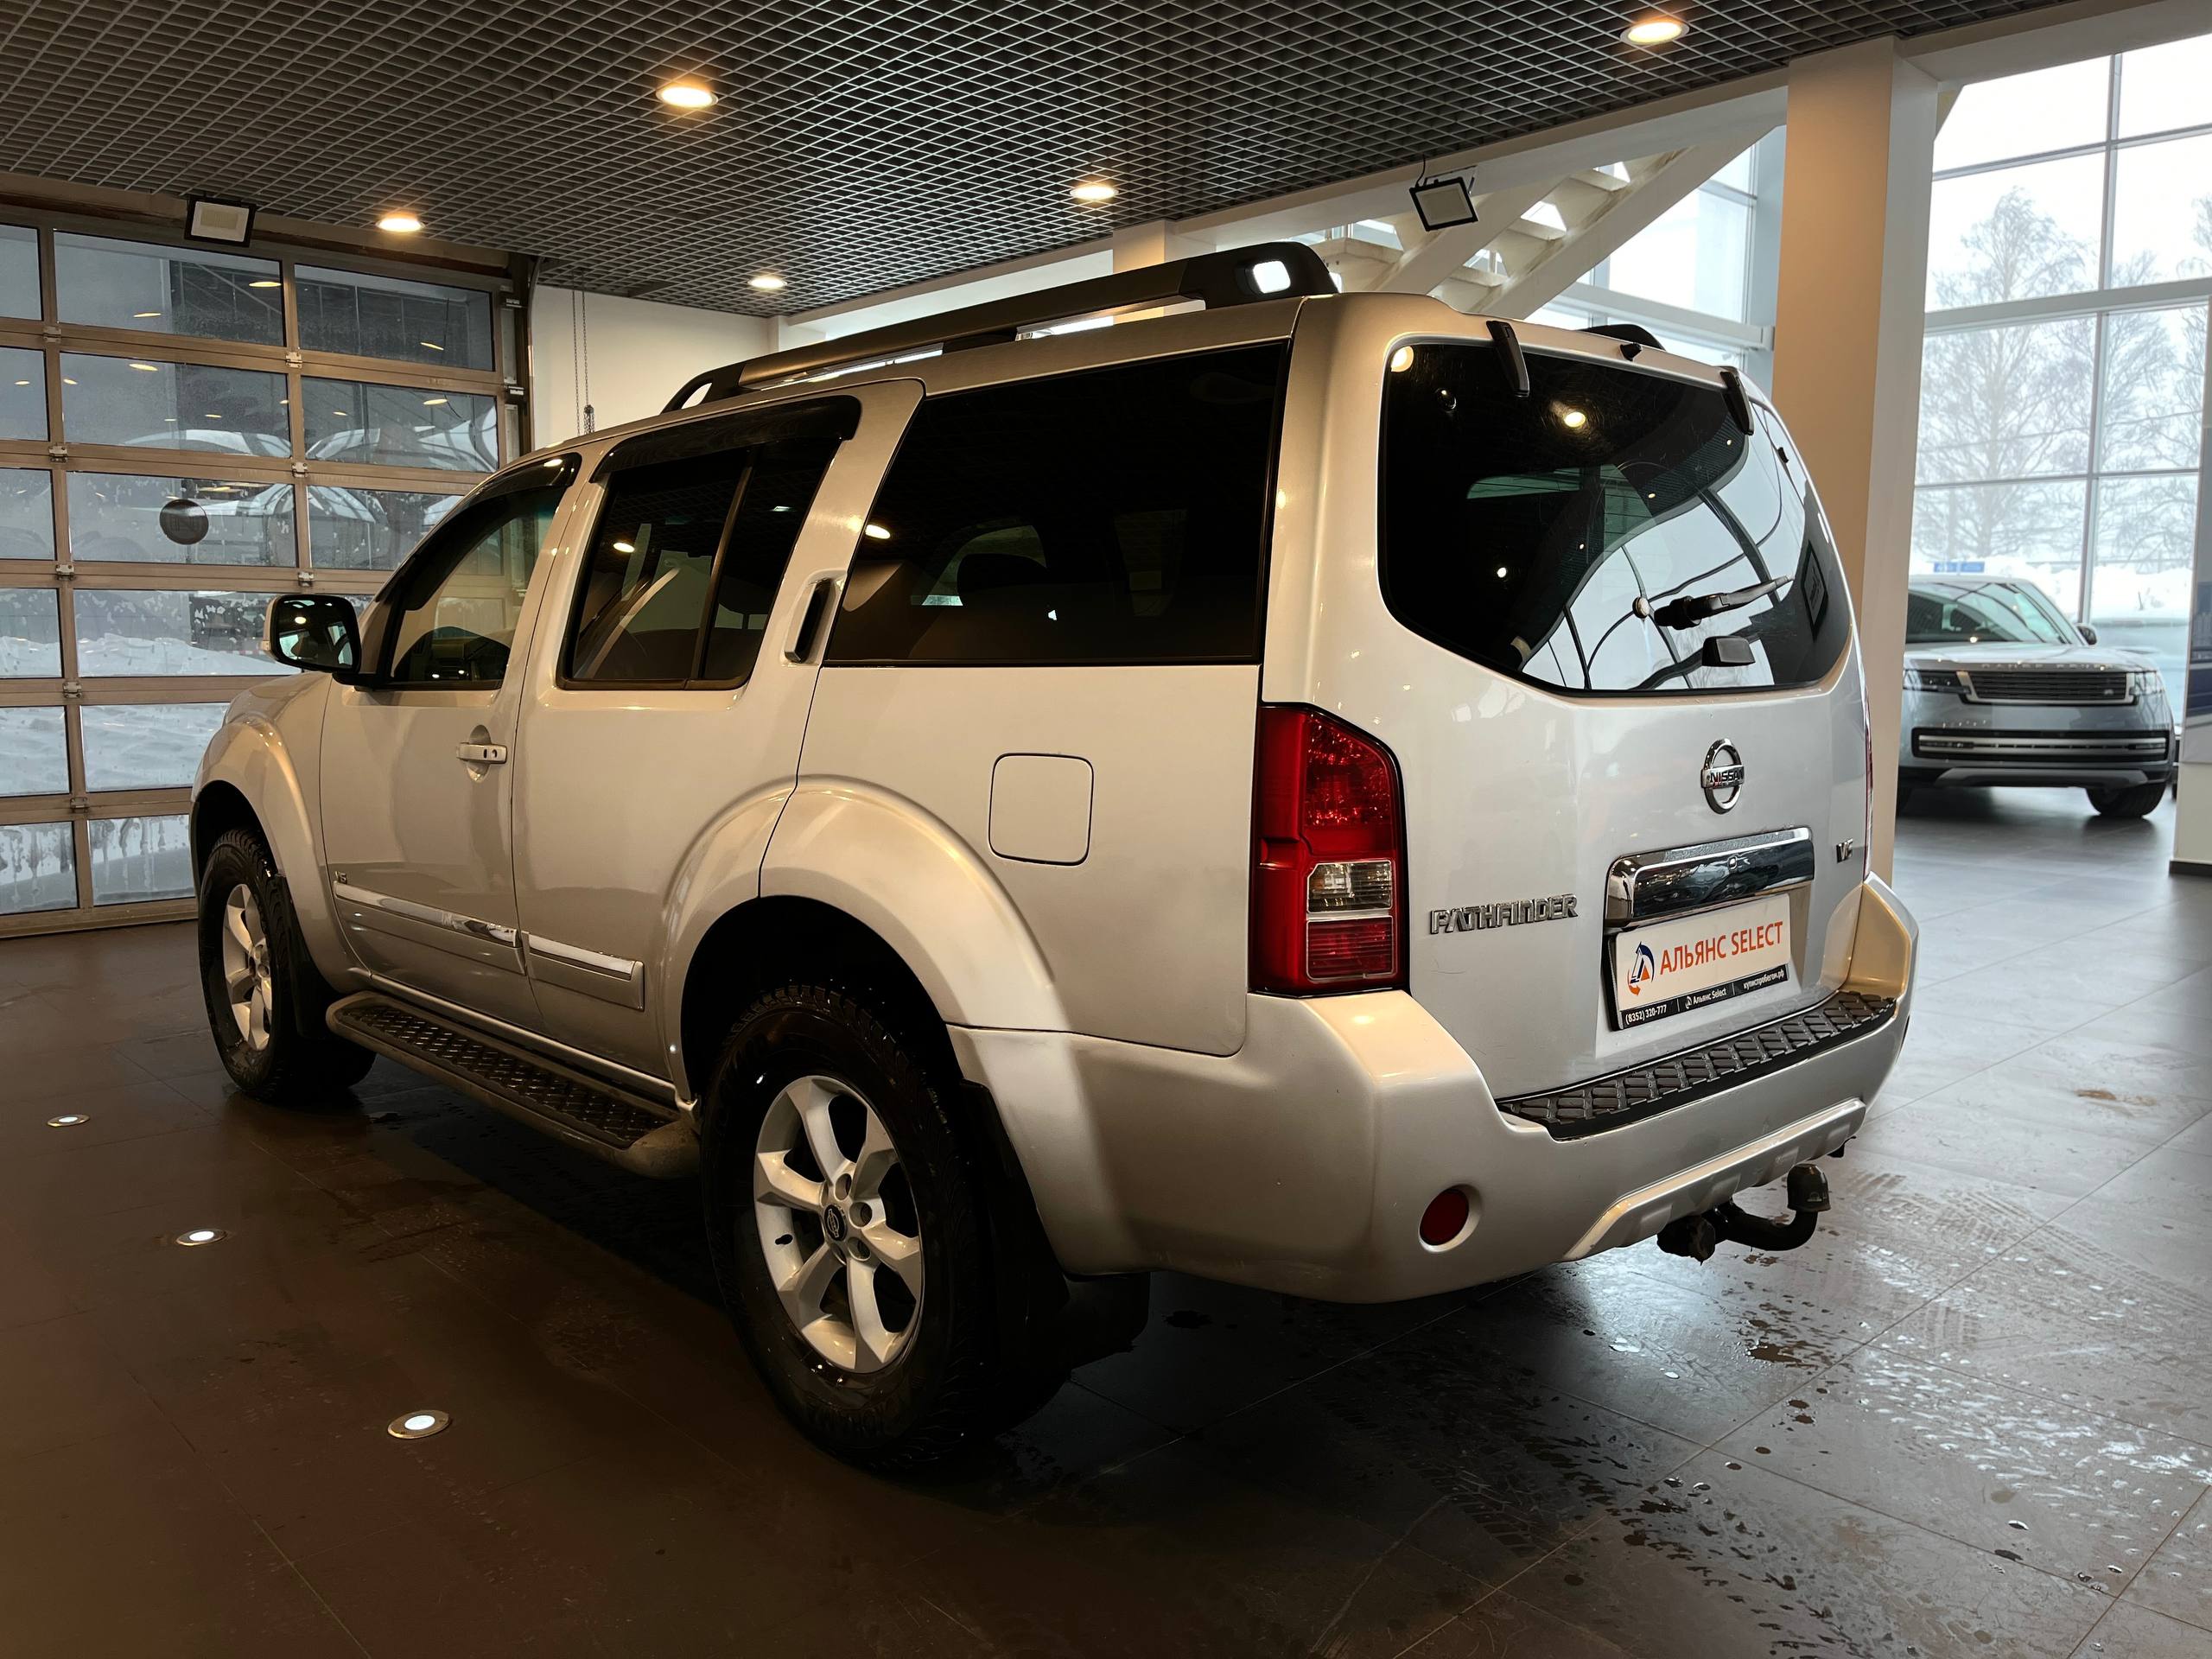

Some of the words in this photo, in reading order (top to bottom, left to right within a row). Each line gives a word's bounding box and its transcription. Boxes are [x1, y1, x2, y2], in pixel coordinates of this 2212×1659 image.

[1710, 768, 1744, 783] NISSAN
[1430, 893, 1578, 934] PATHFINDER
[1660, 935, 1726, 975] АЛЬЯНС
[1731, 921, 1783, 956] SELECT
[1712, 988, 1726, 999] Select
[1625, 1010, 1645, 1025] (8352)
[1645, 1004, 1667, 1018] 320-777
